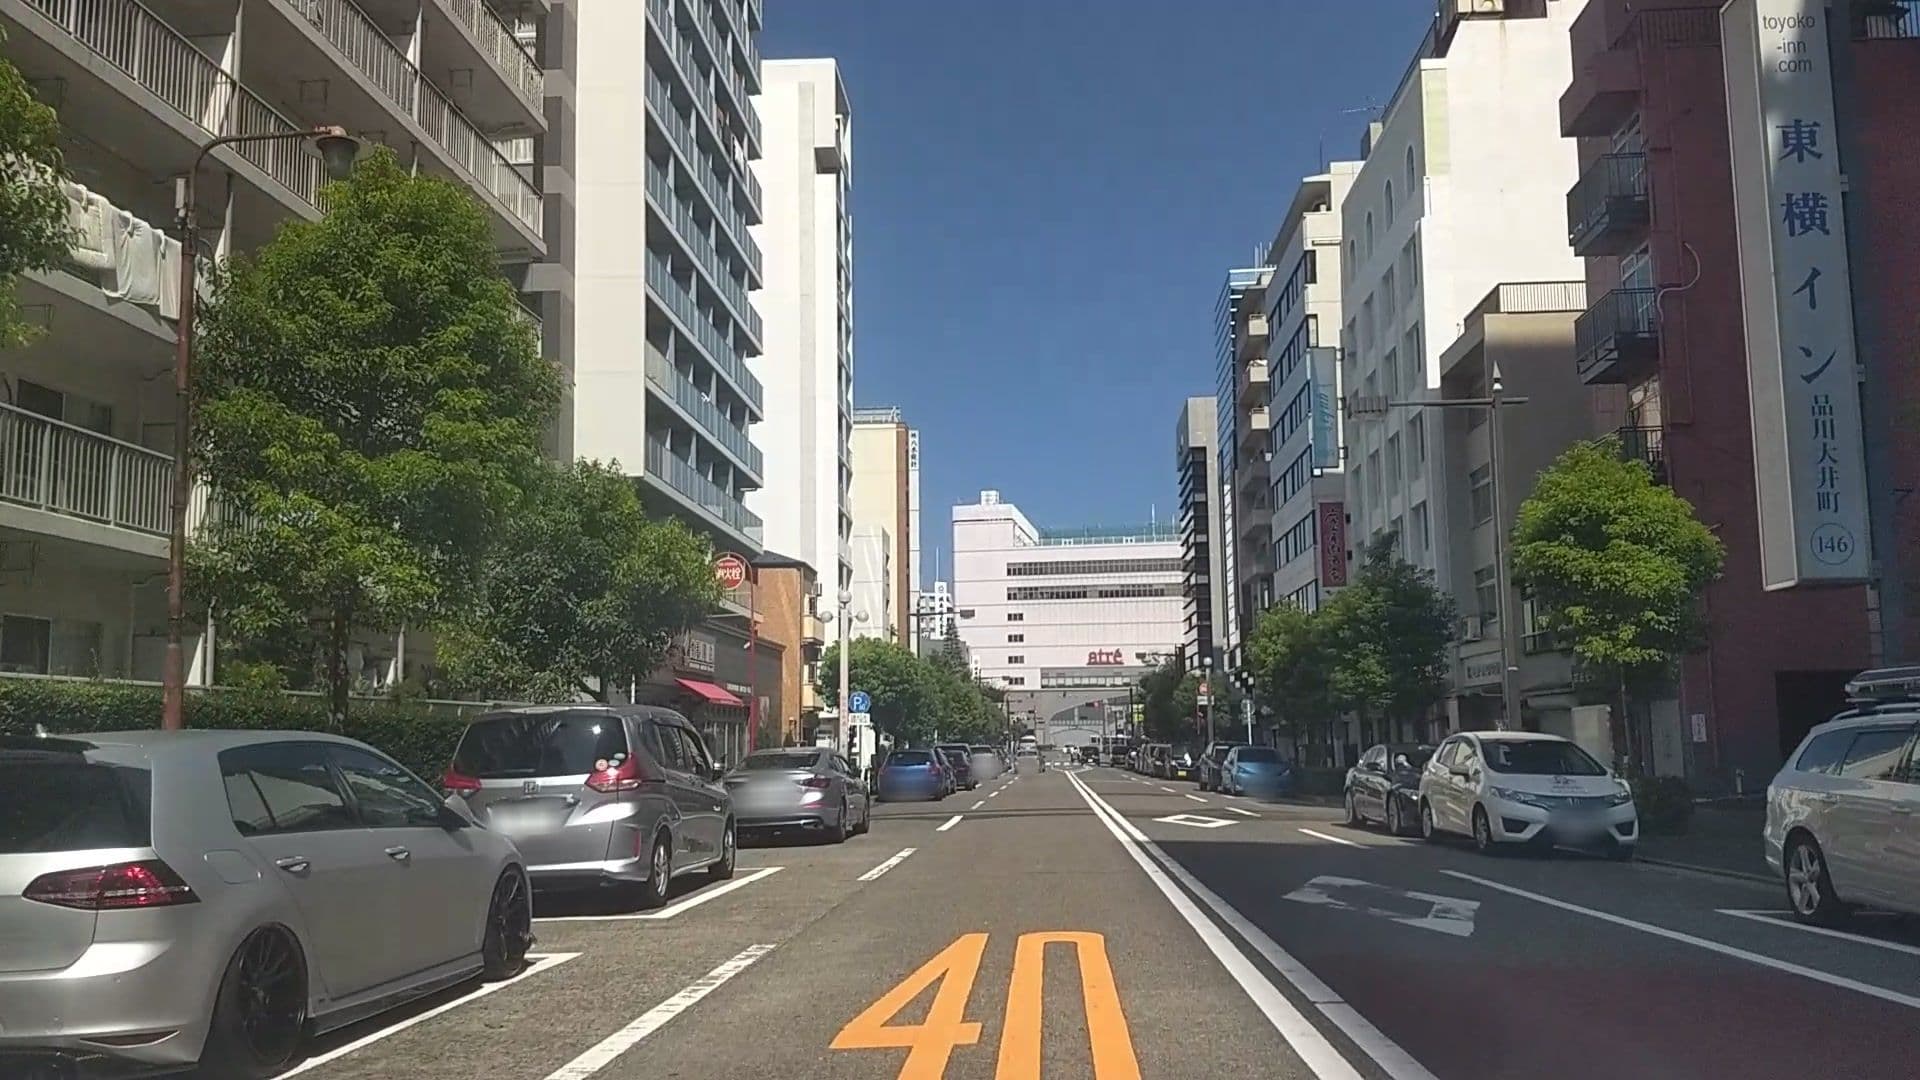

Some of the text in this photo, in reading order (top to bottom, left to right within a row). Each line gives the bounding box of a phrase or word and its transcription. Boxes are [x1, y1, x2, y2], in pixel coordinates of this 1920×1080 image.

[1763, 12, 1816, 34] toyoko
[1776, 38, 1807, 54] -inn
[1775, 59, 1813, 73] .com
[1775, 119, 1837, 386] 東横イン
[1811, 394, 1841, 514] 品川大井町
[1818, 536, 1848, 554] 146
[828, 930, 1142, 1080] 40
